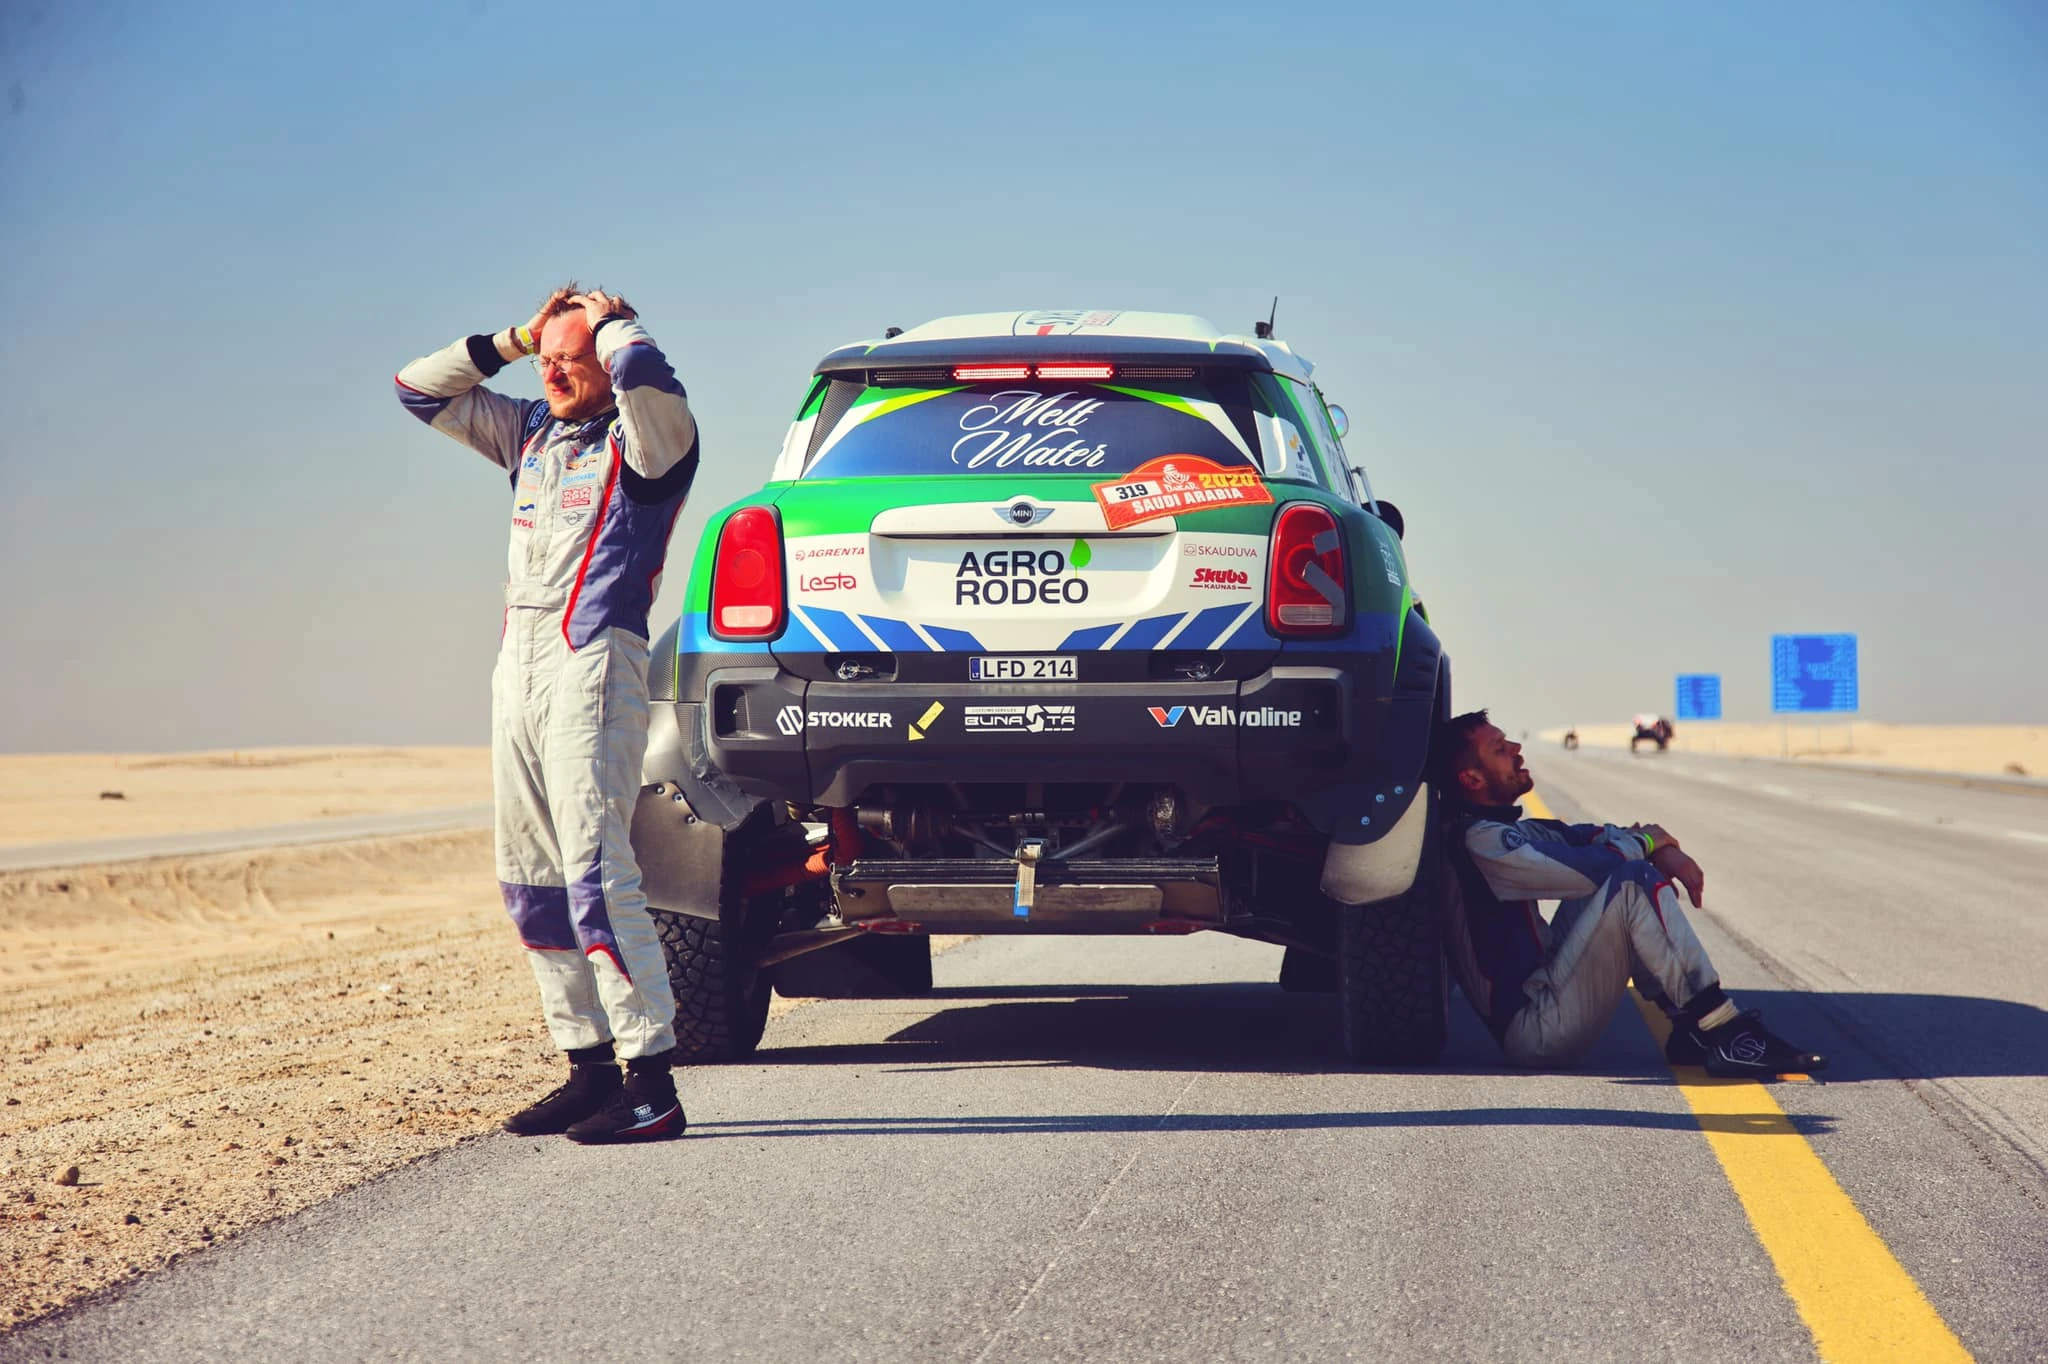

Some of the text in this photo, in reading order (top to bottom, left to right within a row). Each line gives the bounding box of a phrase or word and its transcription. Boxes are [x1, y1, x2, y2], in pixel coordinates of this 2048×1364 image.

[959, 390, 1105, 431] Melt
[951, 427, 1108, 469] Water
[1198, 473, 1256, 489] 2020
[1115, 483, 1149, 500] 319
[1132, 487, 1244, 514] SAUDI ARABIA
[808, 547, 865, 558] AGRENTA
[1198, 546, 1257, 557] SKAUDUVA
[956, 550, 1065, 577] AGRO
[800, 571, 856, 592] Lesta
[1193, 568, 1248, 585] Skuba
[956, 578, 1089, 605] RODEO
[984, 660, 1074, 678] LFD 214
[807, 711, 893, 728] STOKKER
[1188, 705, 1302, 727] Valvoline
